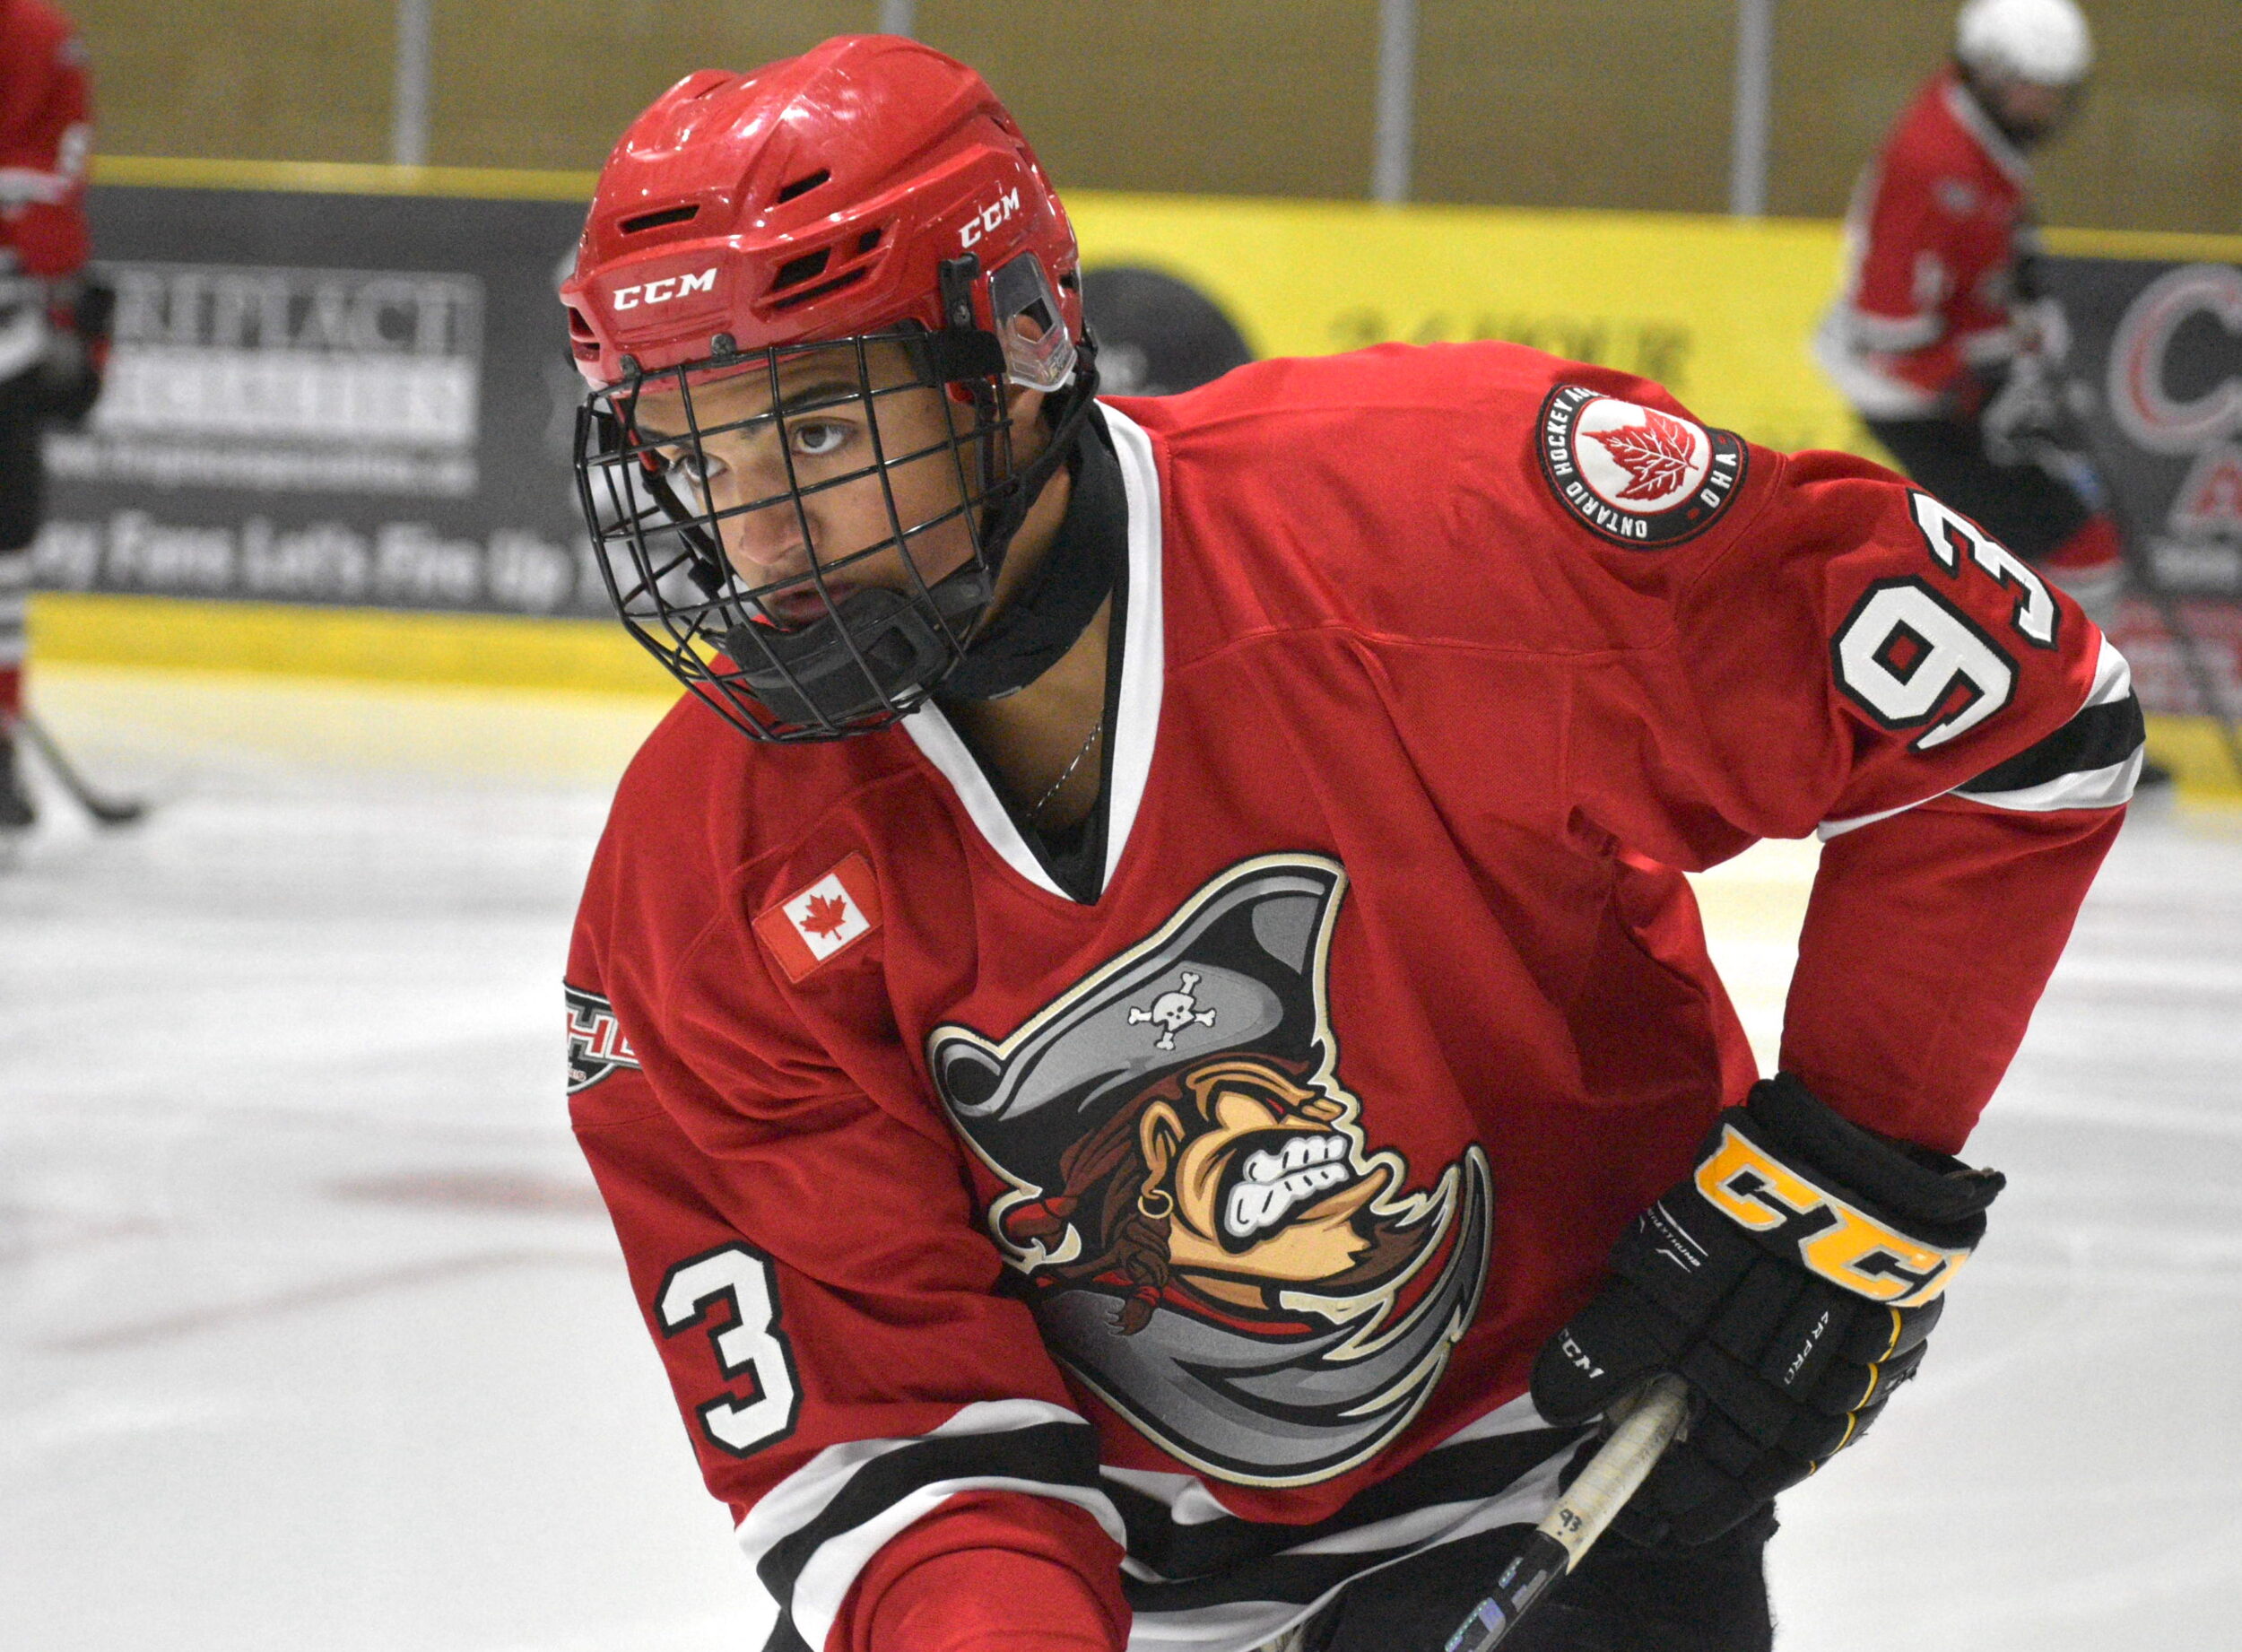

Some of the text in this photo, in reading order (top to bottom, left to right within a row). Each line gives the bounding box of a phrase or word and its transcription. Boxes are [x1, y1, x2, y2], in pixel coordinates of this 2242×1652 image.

[959, 187, 1020, 249] CCM
[613, 268, 717, 311] CCM
[1546, 397, 1575, 476] HOCKEY
[1565, 480, 1648, 539] ONTARIO
[1700, 452, 1738, 509] OHA
[1834, 490, 2057, 752] 93
[657, 1245, 799, 1454] 3
[1784, 1339, 1812, 1385] PRO
